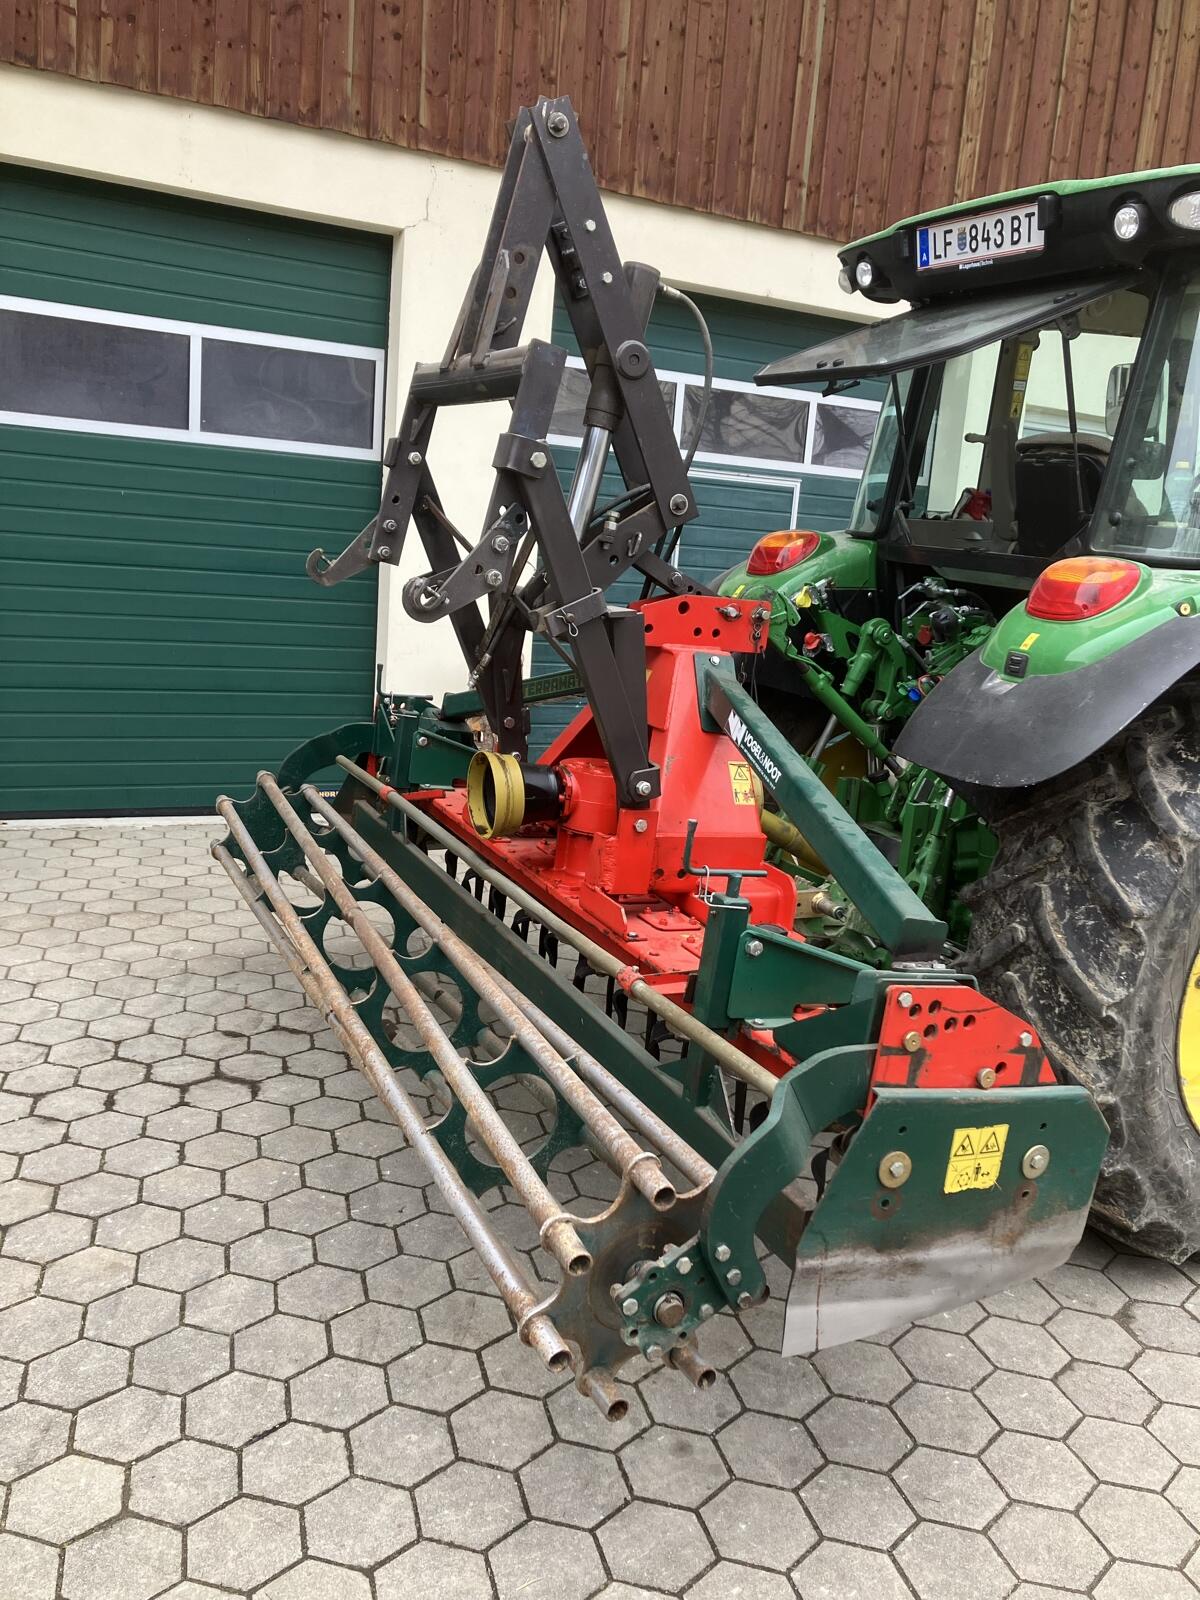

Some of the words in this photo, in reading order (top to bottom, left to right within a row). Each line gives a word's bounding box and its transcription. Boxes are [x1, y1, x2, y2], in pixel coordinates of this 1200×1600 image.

[933, 228, 953, 260] LF
[968, 218, 1005, 253] 843
[1010, 211, 1036, 246] BT
